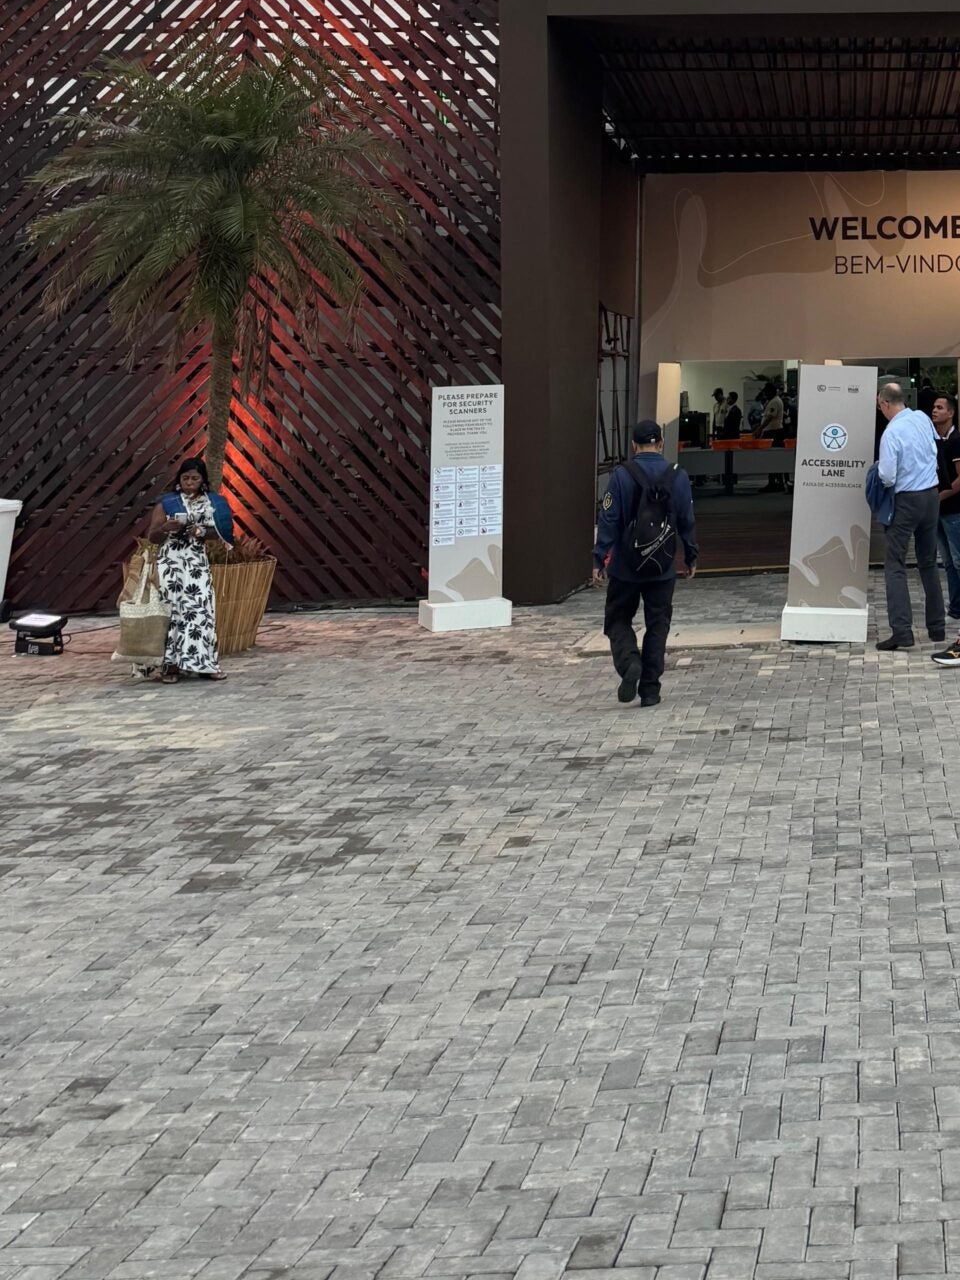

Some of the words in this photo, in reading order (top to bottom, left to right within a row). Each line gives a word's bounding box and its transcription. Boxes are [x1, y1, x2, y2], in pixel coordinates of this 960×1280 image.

[449, 407, 488, 415] SCANNERS
[801, 458, 866, 469] ACCESSIBILITY
[821, 469, 845, 477] LANE
